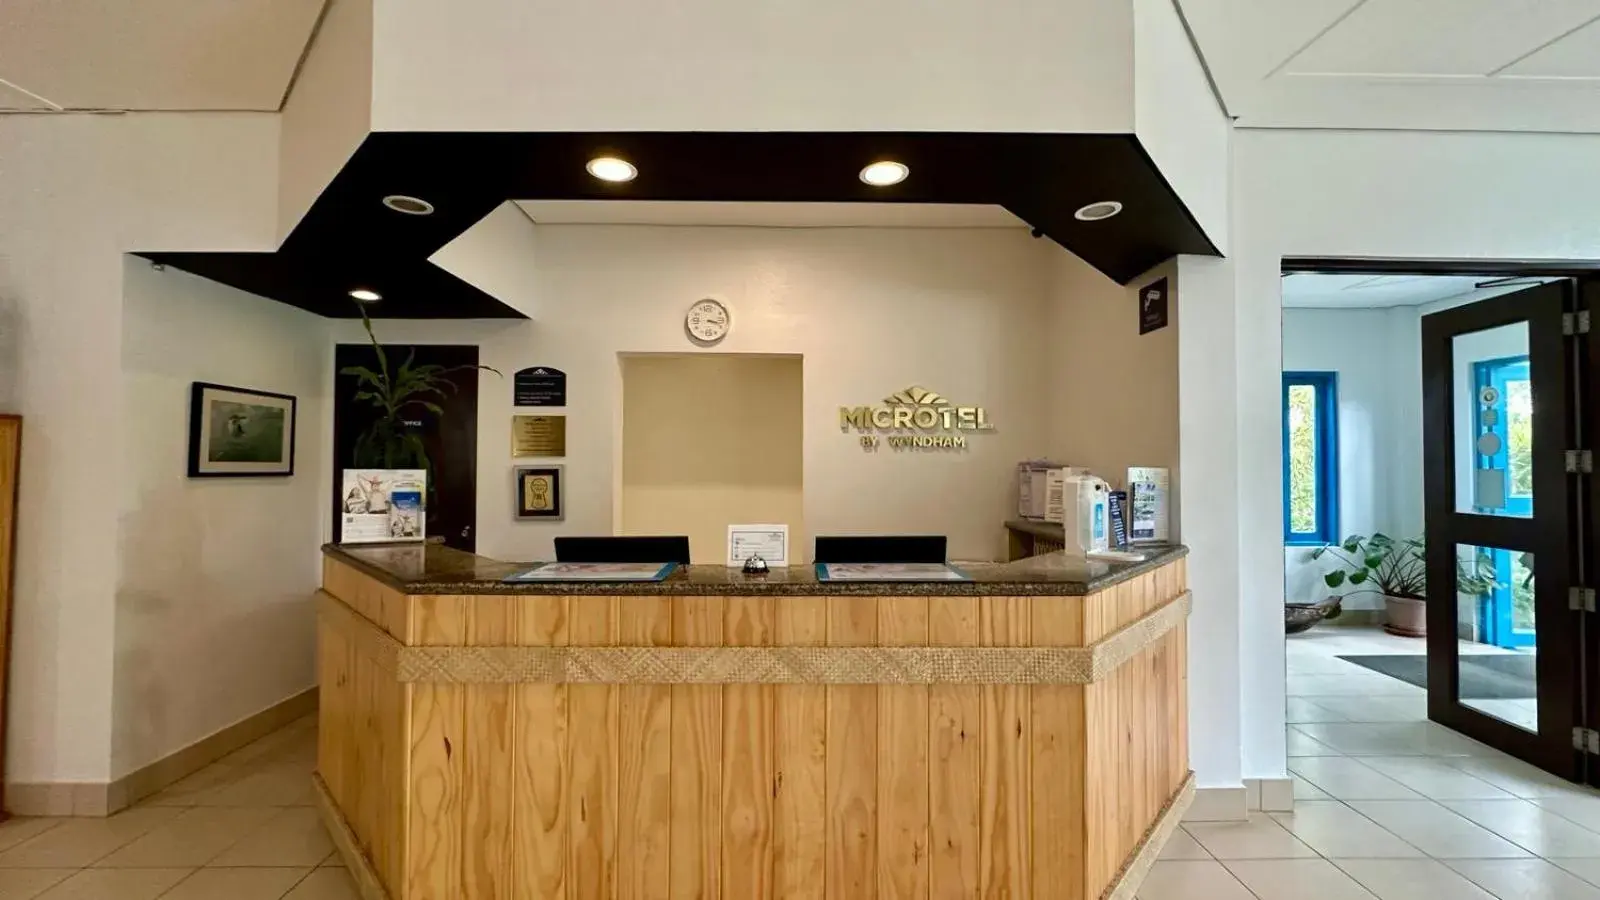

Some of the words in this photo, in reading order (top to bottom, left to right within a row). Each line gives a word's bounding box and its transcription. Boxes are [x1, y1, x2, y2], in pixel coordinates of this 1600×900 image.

[839, 406, 995, 429] MICROTEL
[860, 435, 878, 448] BY
[887, 435, 966, 448] WYNDHAM
